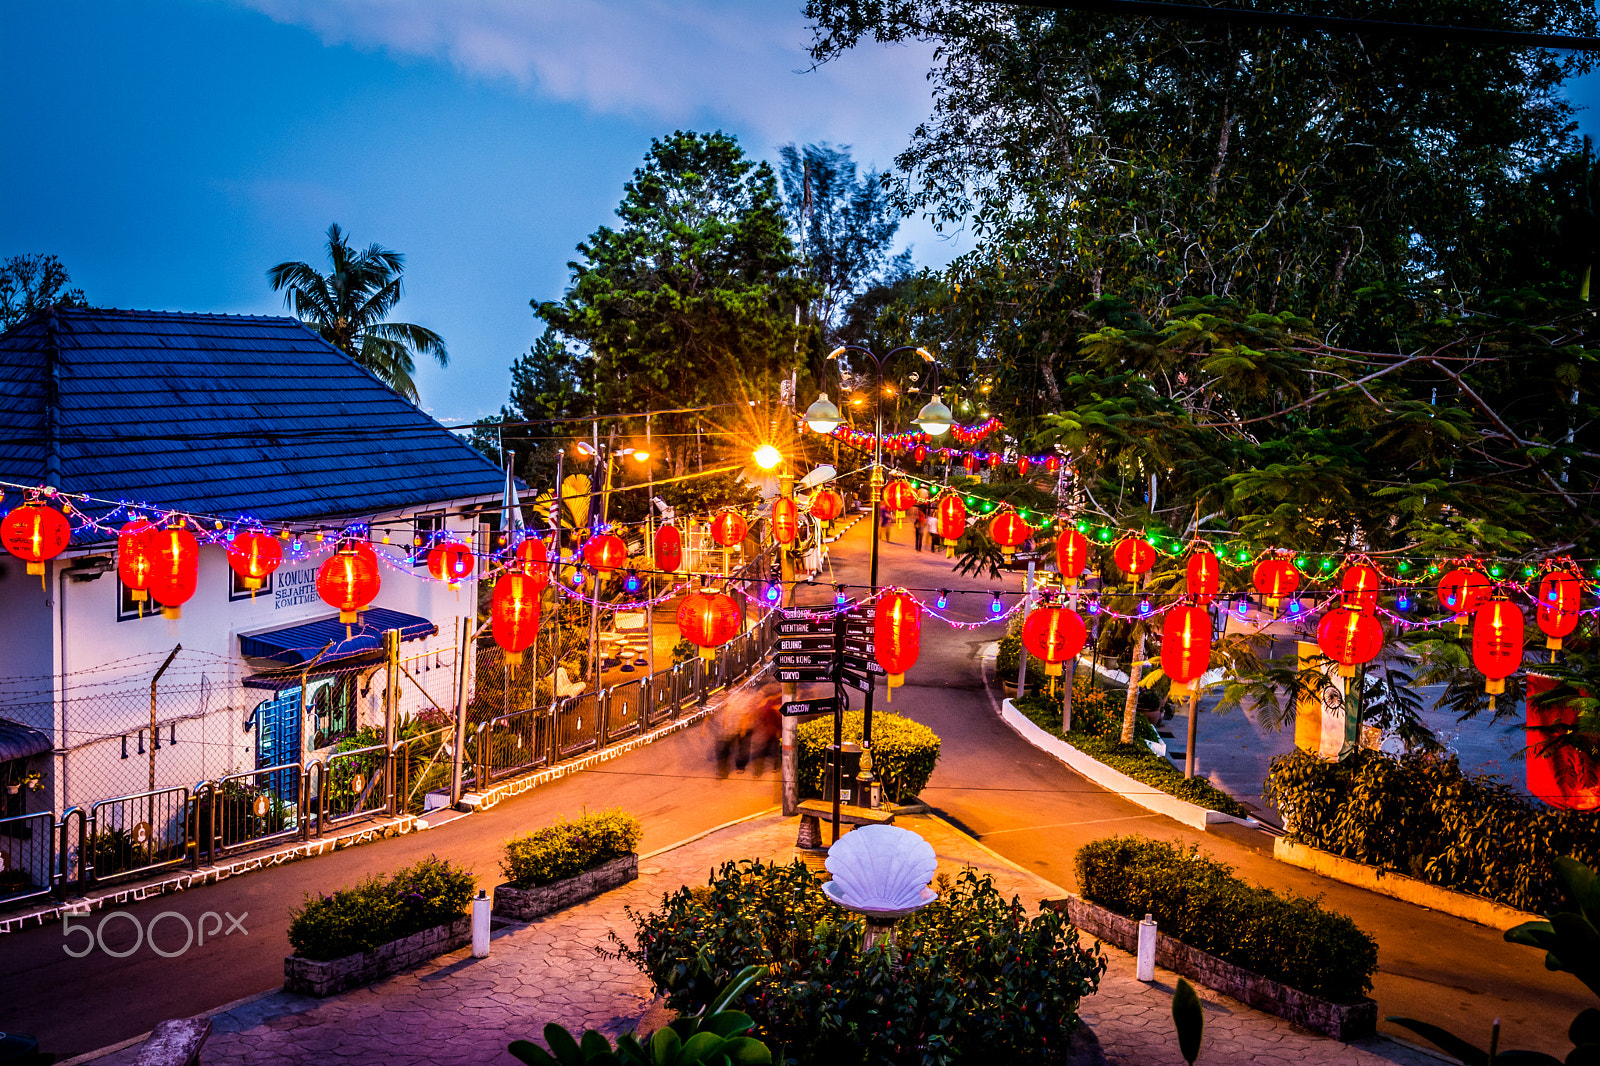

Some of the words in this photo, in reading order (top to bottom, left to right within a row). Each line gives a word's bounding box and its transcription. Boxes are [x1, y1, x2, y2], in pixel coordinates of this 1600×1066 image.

[275, 584, 317, 599] SEJAHTE
[780, 624, 809, 633] VIENTIANE
[781, 640, 802, 650] BEIJING
[779, 655, 795, 664] HONG
[796, 655, 812, 665] KONG
[780, 671, 800, 680] TOKYO
[786, 704, 811, 714] MOSCOW
